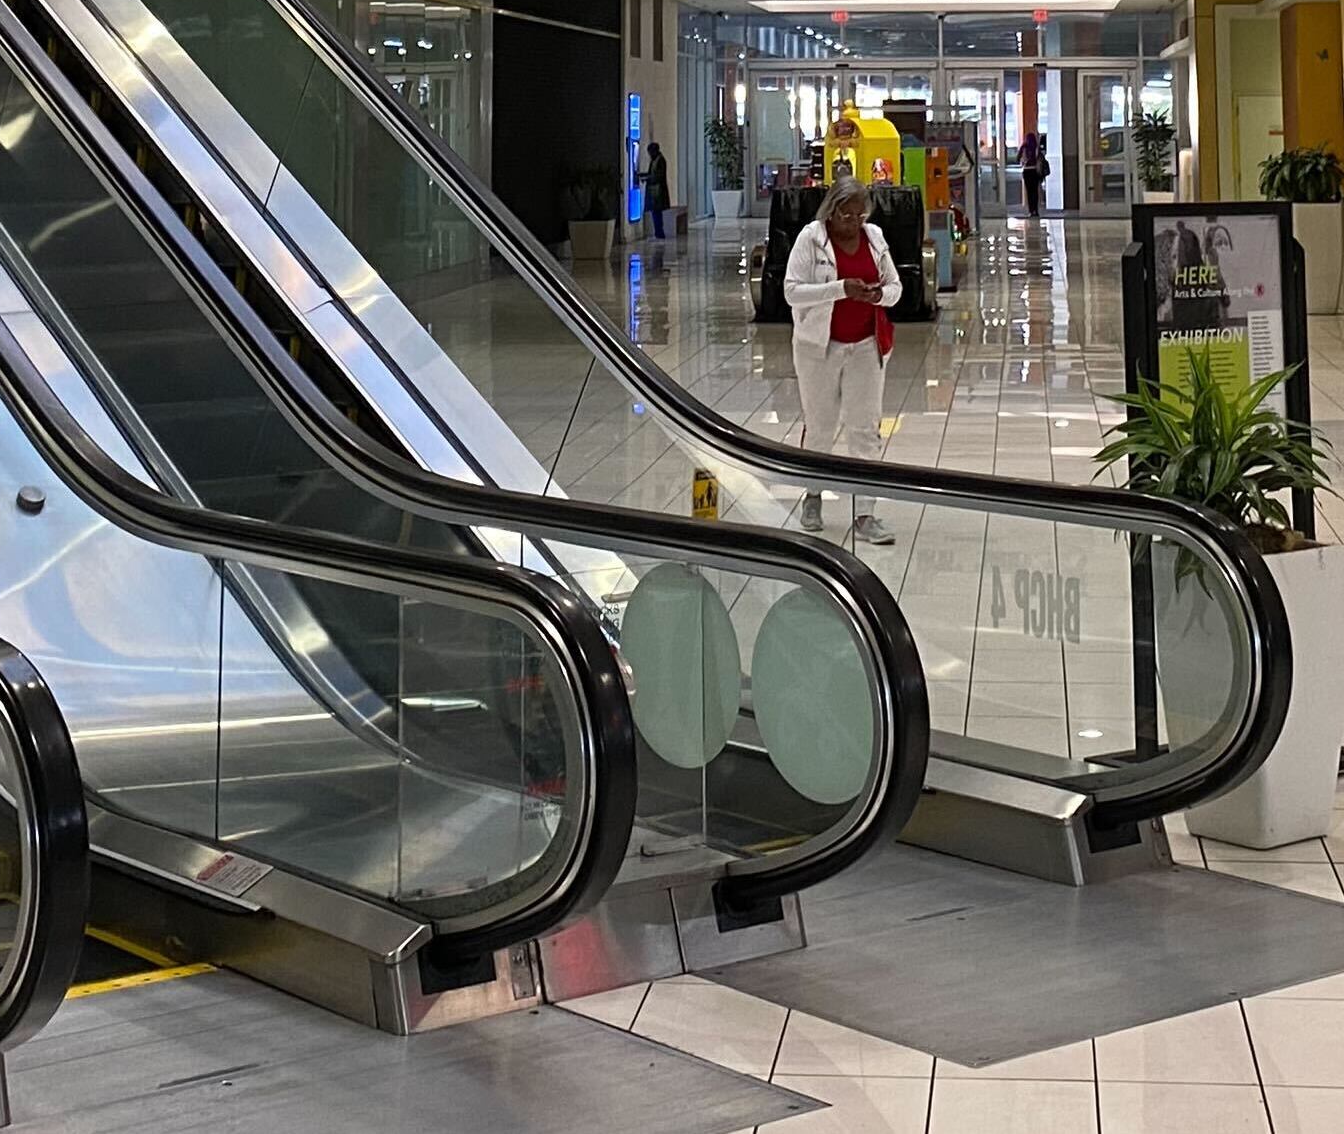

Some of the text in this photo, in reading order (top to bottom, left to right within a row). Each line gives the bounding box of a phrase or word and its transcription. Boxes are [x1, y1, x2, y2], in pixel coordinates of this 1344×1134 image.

[1174, 266, 1218, 285] HERE
[1174, 289, 1189, 298] Arts
[1190, 288, 1197, 298] &
[1197, 288, 1222, 298] Culture
[1159, 327, 1244, 347] EXHIBITION
